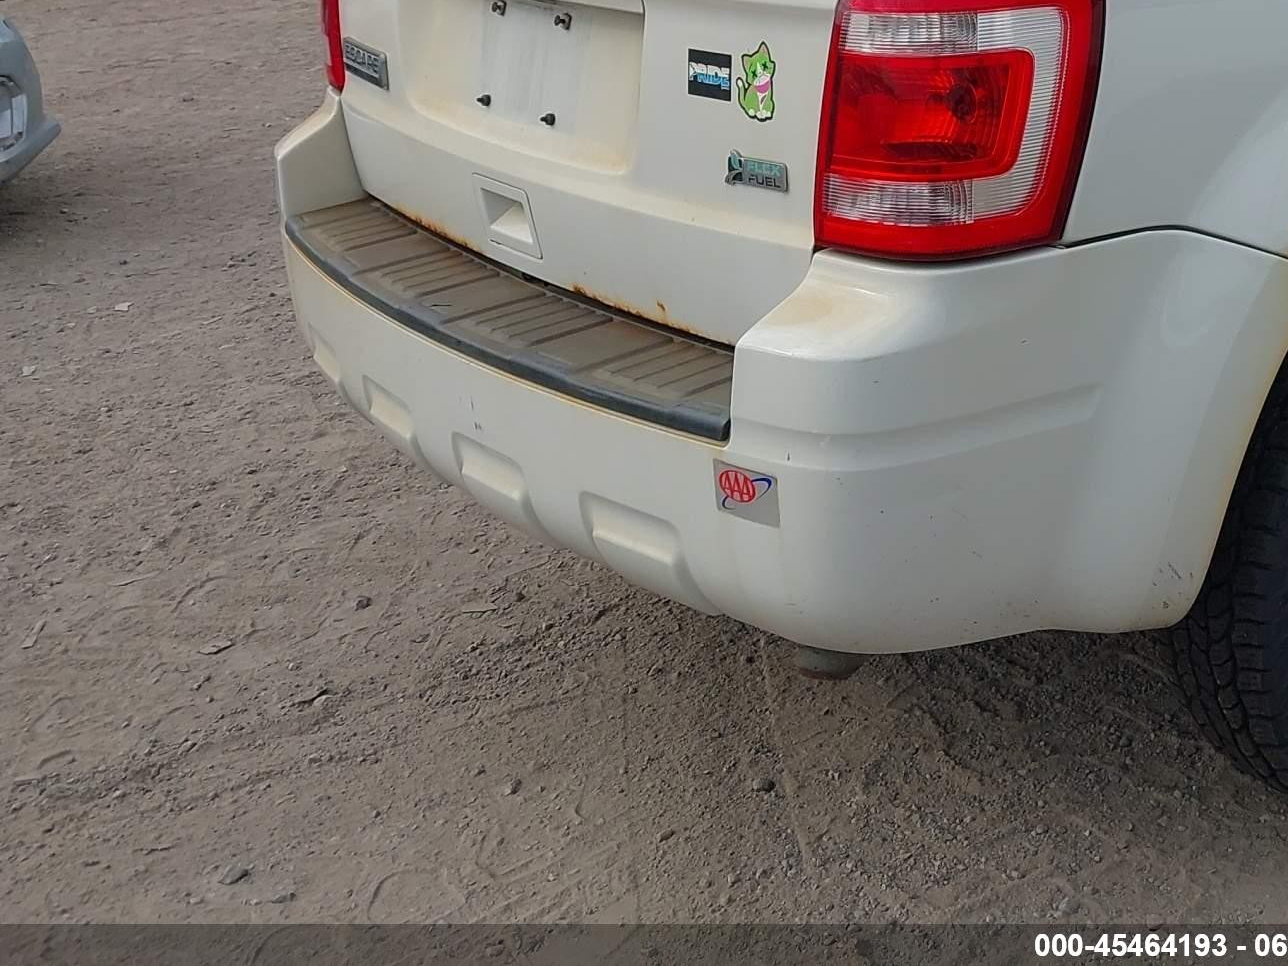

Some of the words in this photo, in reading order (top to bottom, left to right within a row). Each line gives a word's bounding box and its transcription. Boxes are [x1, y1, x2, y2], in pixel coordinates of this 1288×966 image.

[688, 61, 730, 90] PRIDE
[747, 161, 780, 178] FLEX
[748, 173, 782, 189] FUEL
[722, 471, 754, 501] AAA
